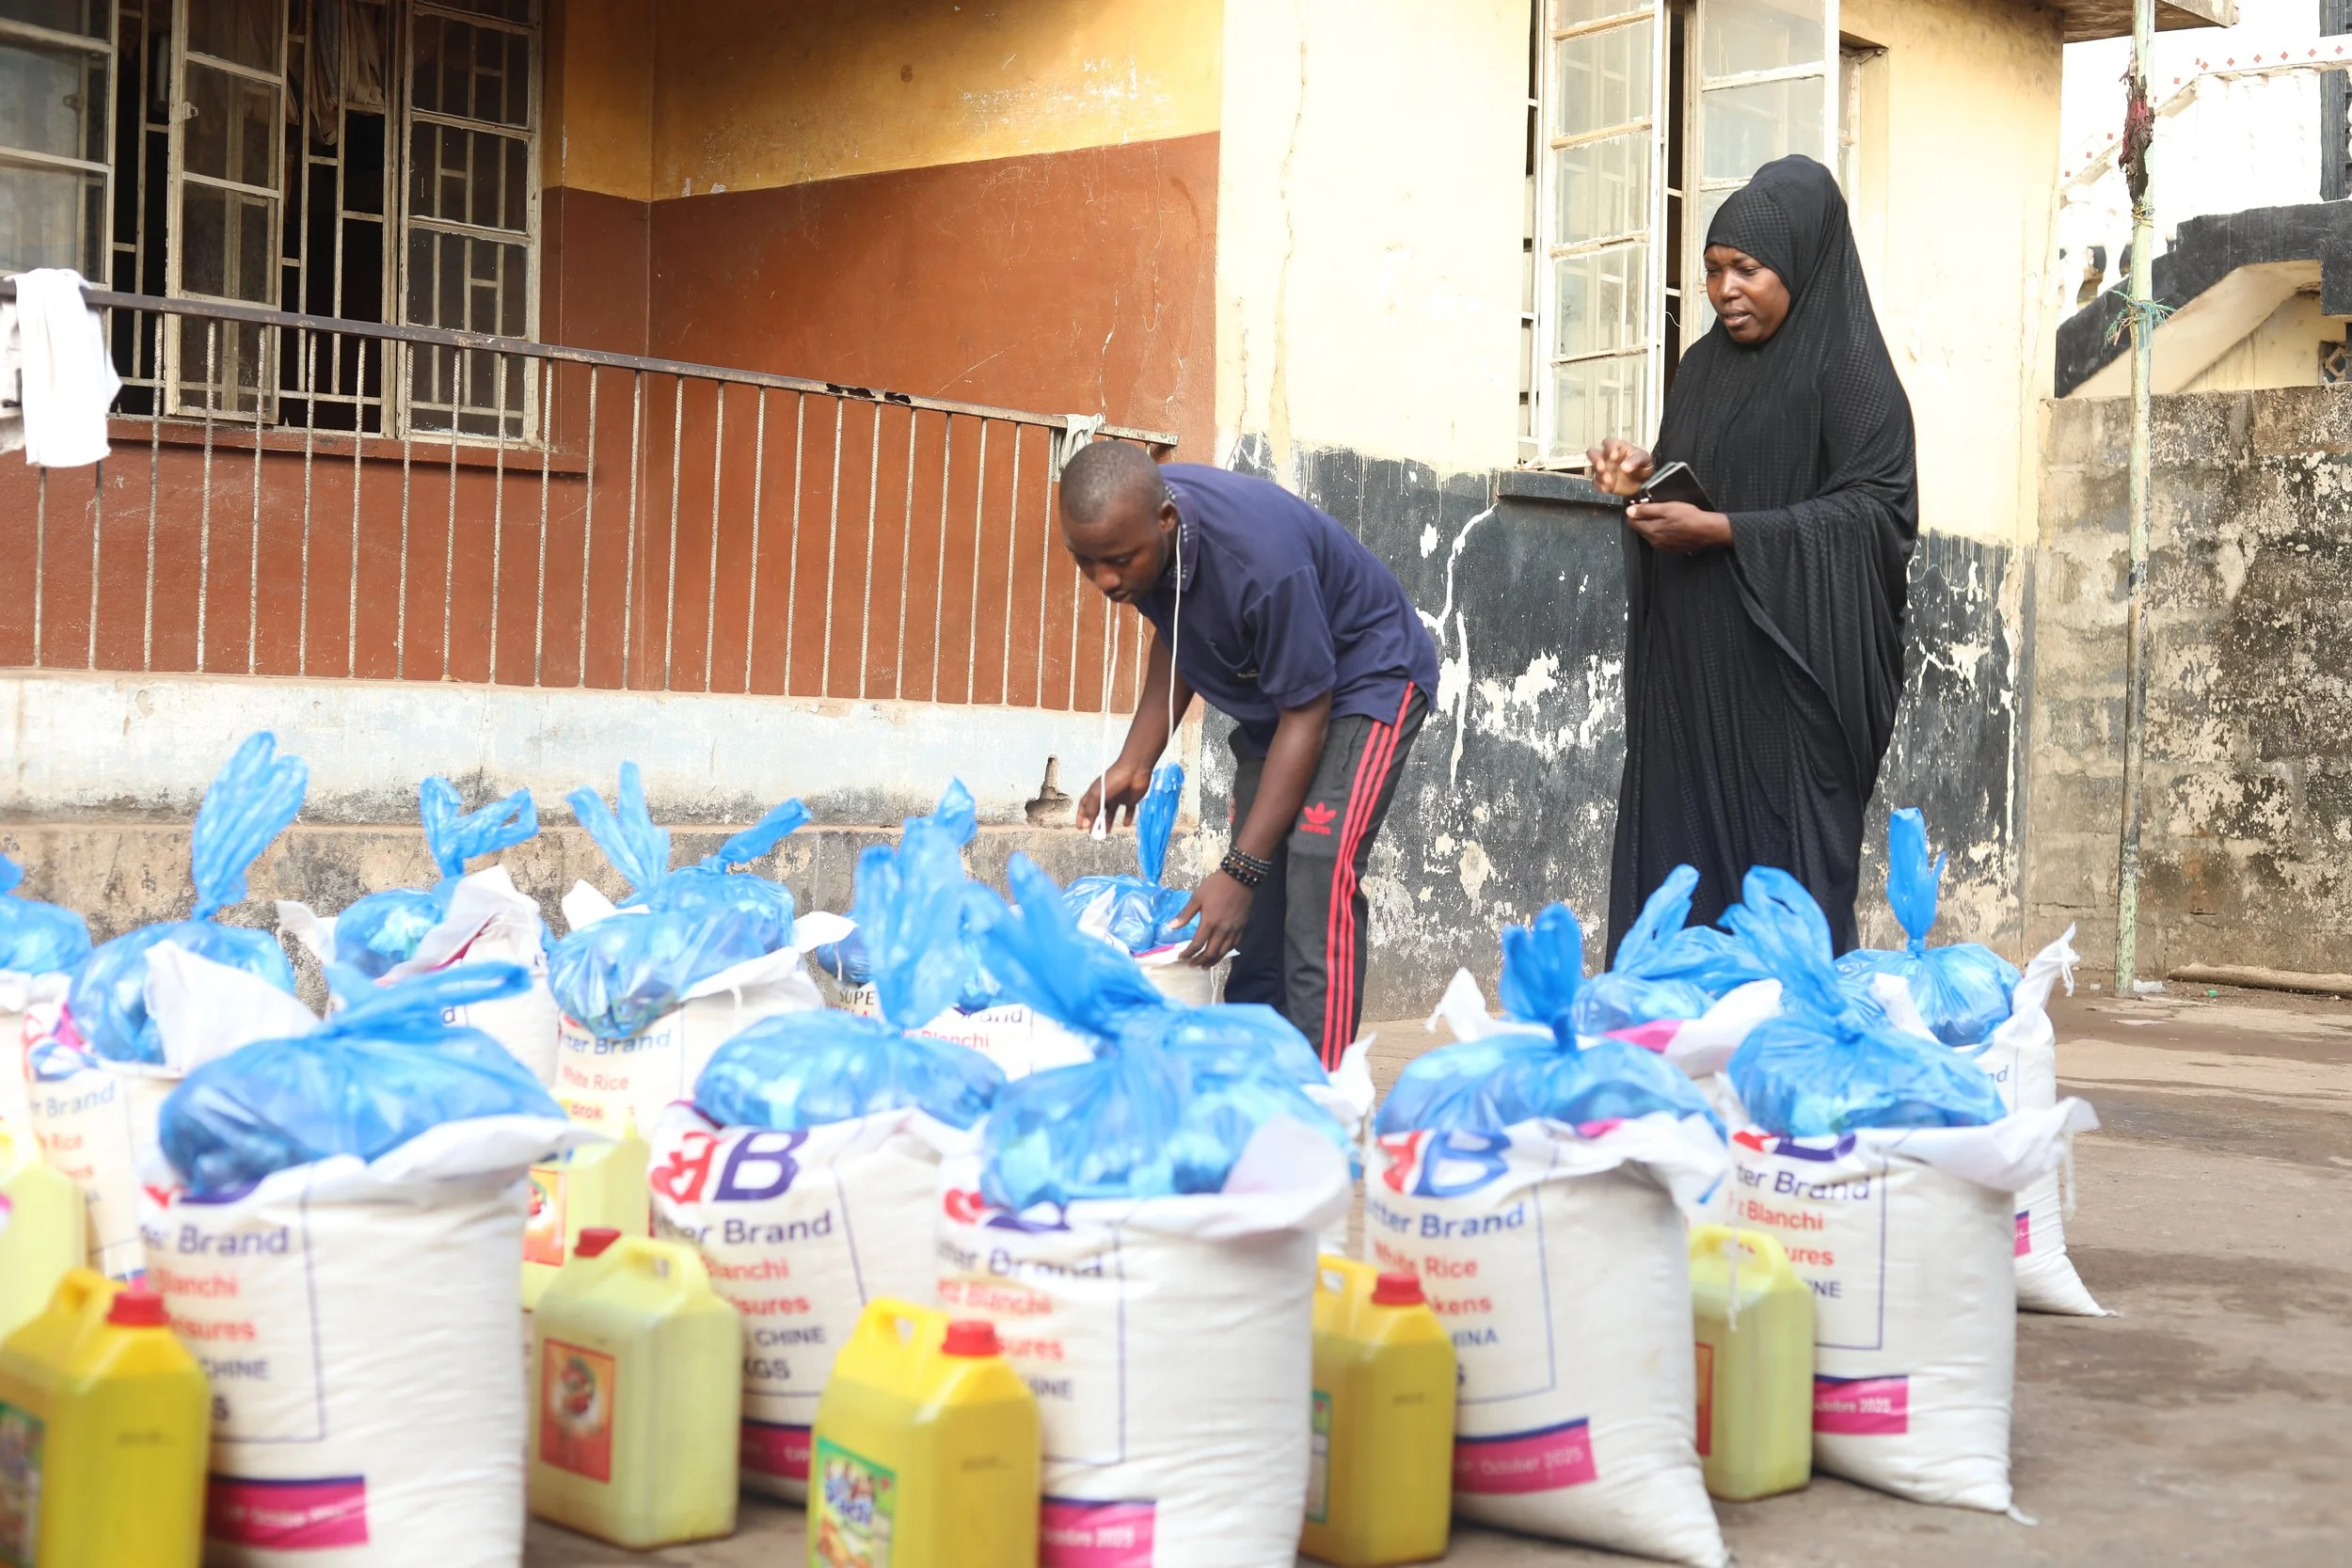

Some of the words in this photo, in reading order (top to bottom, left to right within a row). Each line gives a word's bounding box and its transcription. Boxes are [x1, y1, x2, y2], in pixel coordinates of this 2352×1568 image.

[595, 1029, 671, 1054] Brand
[594, 1074, 628, 1091] Rice
[47, 1080, 115, 1117] Brand
[1737, 1164, 1767, 1187] ter
[1774, 1170, 1870, 1200] Brand
[723, 1211, 832, 1244] Brand
[1421, 1201, 1525, 1239] Brand
[1747, 1199, 1824, 1231] Blanchi
[178, 1225, 290, 1256] Brand
[1425, 1256, 1478, 1278] Rice
[755, 1326, 825, 1347] CHINE
